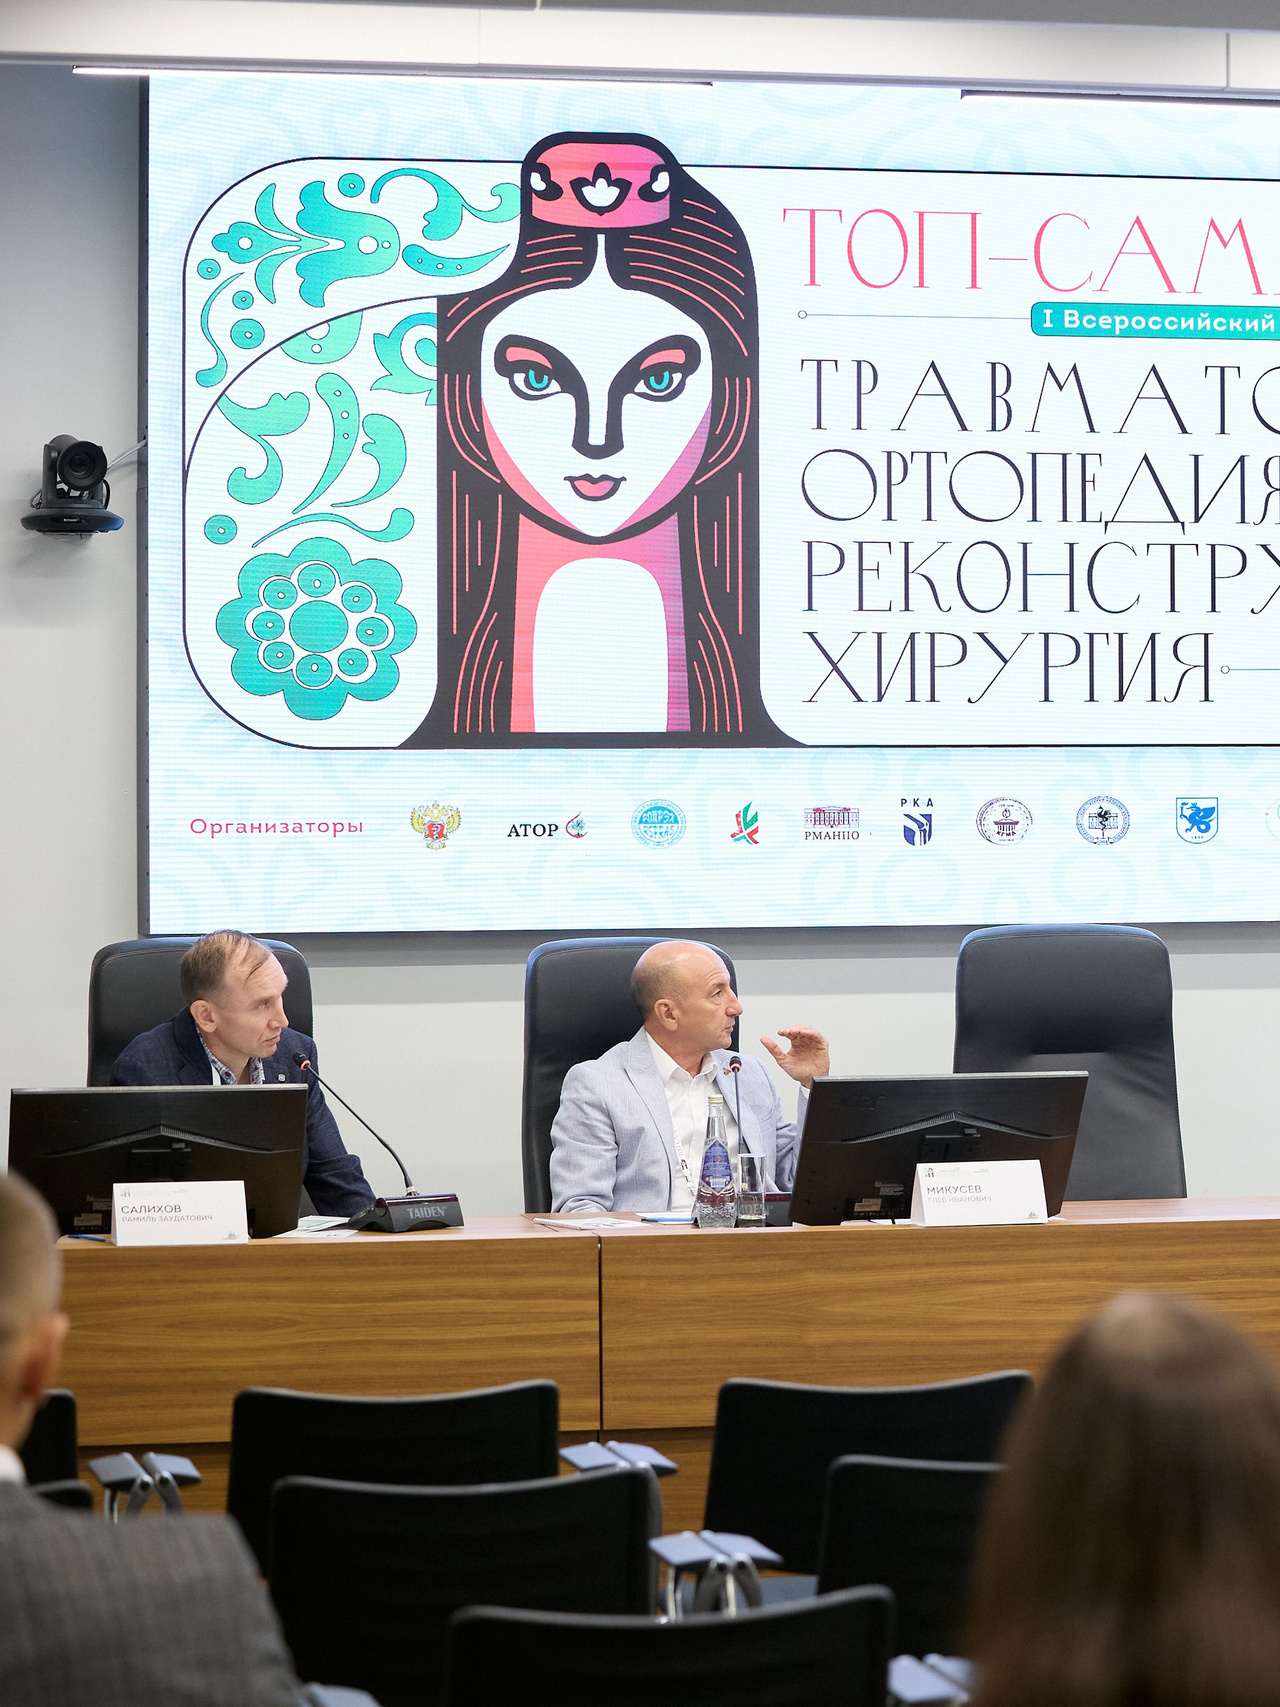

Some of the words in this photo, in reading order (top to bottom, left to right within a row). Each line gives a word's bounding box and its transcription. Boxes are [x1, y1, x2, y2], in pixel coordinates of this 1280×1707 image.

[1063, 308, 1275, 335] Всероссийский
[801, 631, 1216, 705] ХИРУРГИЯ
[190, 818, 363, 840] Организаторы
[507, 823, 559, 837] АТОР
[804, 830, 860, 840] РМАНПО
[926, 1184, 982, 1195] МИКУСЕВ
[948, 1195, 992, 1203] ИВАНОВИЧ
[120, 1204, 182, 1214] САЛИХОВ
[407, 1205, 445, 1219] TAIDEN
[158, 1214, 213, 1222] ЗАУДАТОВИЧ
